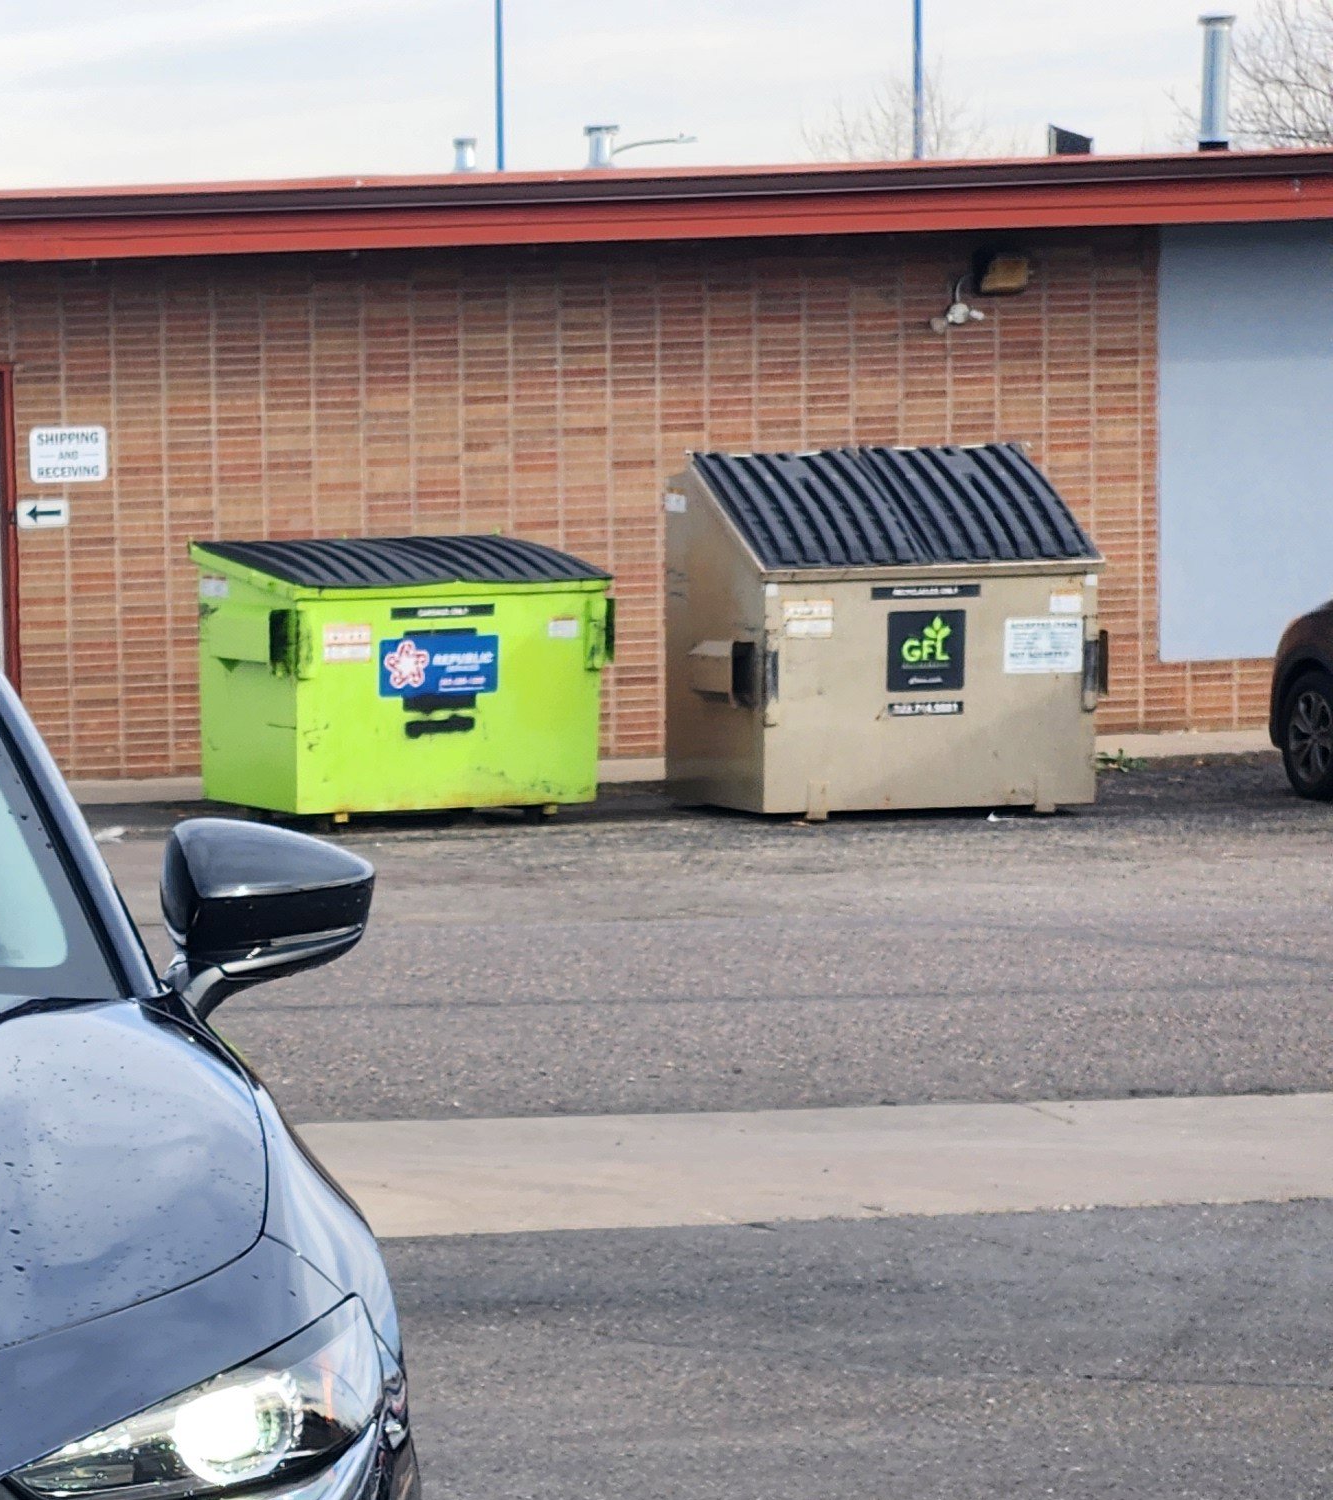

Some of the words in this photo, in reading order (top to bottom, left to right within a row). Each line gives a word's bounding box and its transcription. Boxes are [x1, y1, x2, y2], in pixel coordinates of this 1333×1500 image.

[36, 432, 99, 445] SHIPPING
[57, 451, 79, 460] AND
[36, 465, 100, 478] RECEIVING
[901, 636, 951, 663] GFL
